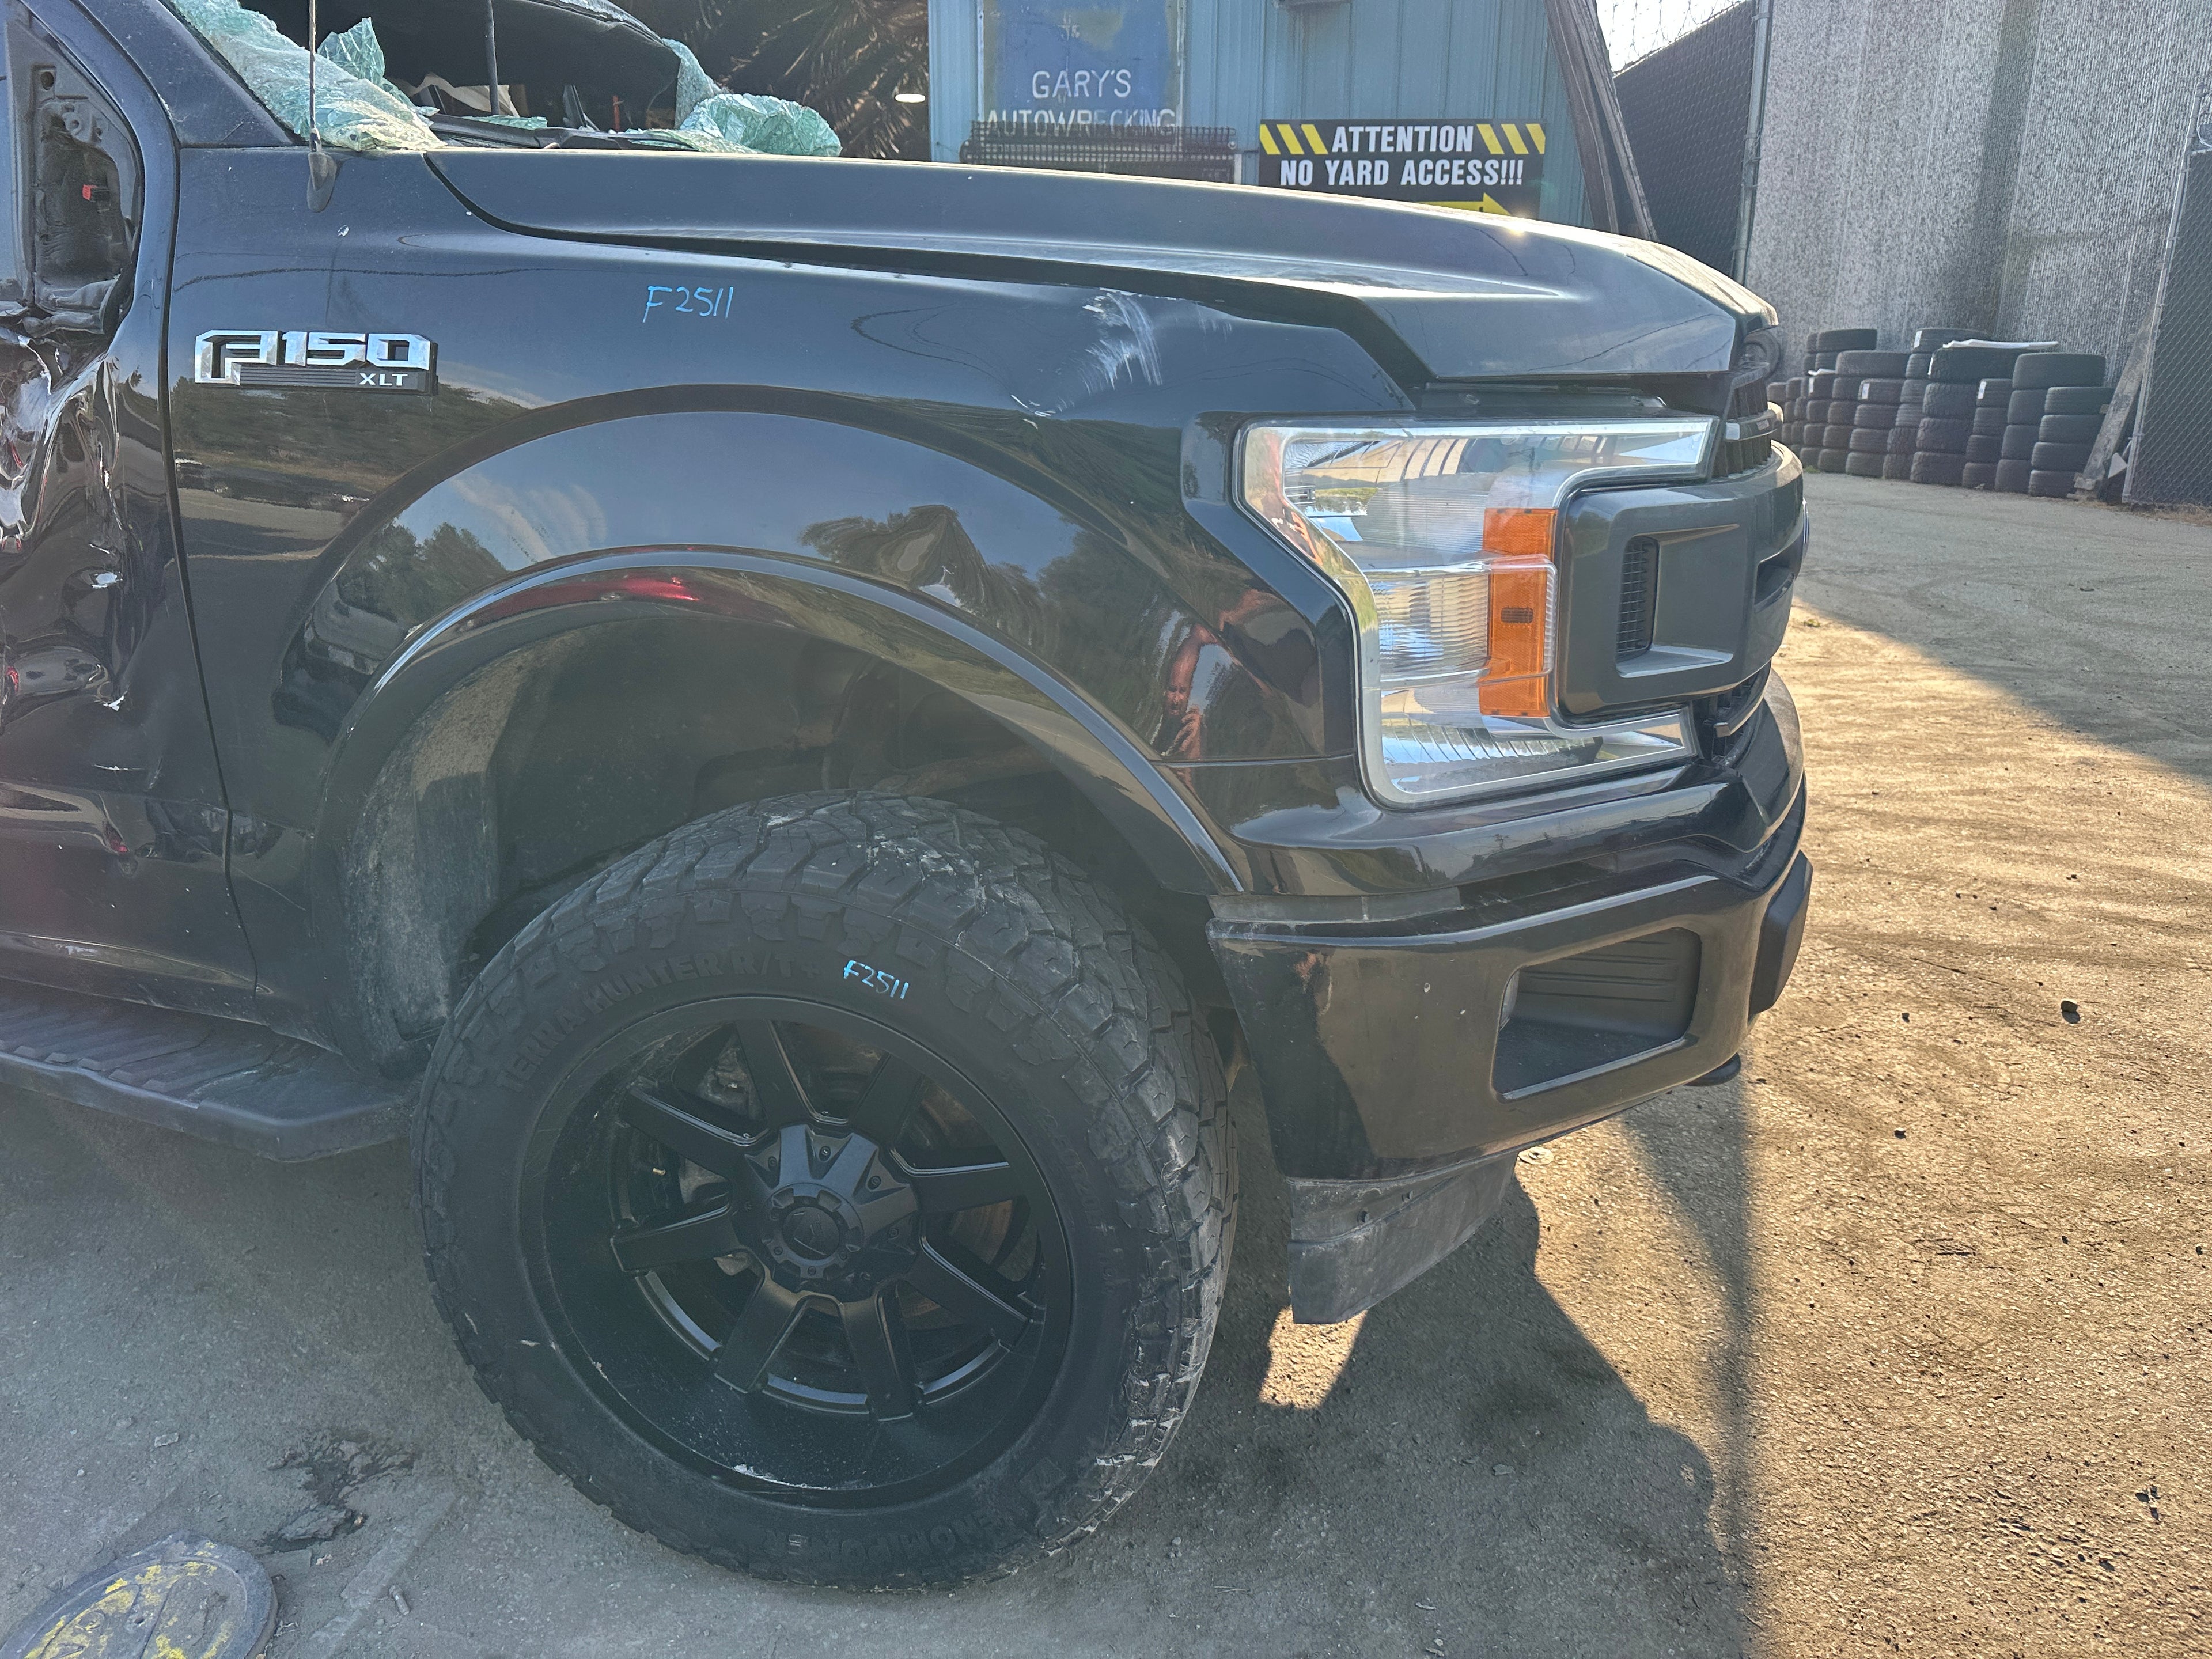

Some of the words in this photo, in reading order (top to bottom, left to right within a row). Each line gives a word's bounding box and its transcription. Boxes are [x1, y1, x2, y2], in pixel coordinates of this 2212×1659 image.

[1032, 69, 1131, 99] GARY'S
[1331, 125, 1474, 153] ATTENTION
[1280, 159, 1313, 187] NO
[1325, 159, 1389, 186] YARD
[1400, 158, 1524, 185] ACCESS!!!
[642, 286, 734, 323] F2511
[359, 373, 408, 386] XLT
[843, 960, 909, 999] F2511
[494, 1006, 586, 1092] TERRA
[581, 952, 724, 1016] HUNTER
